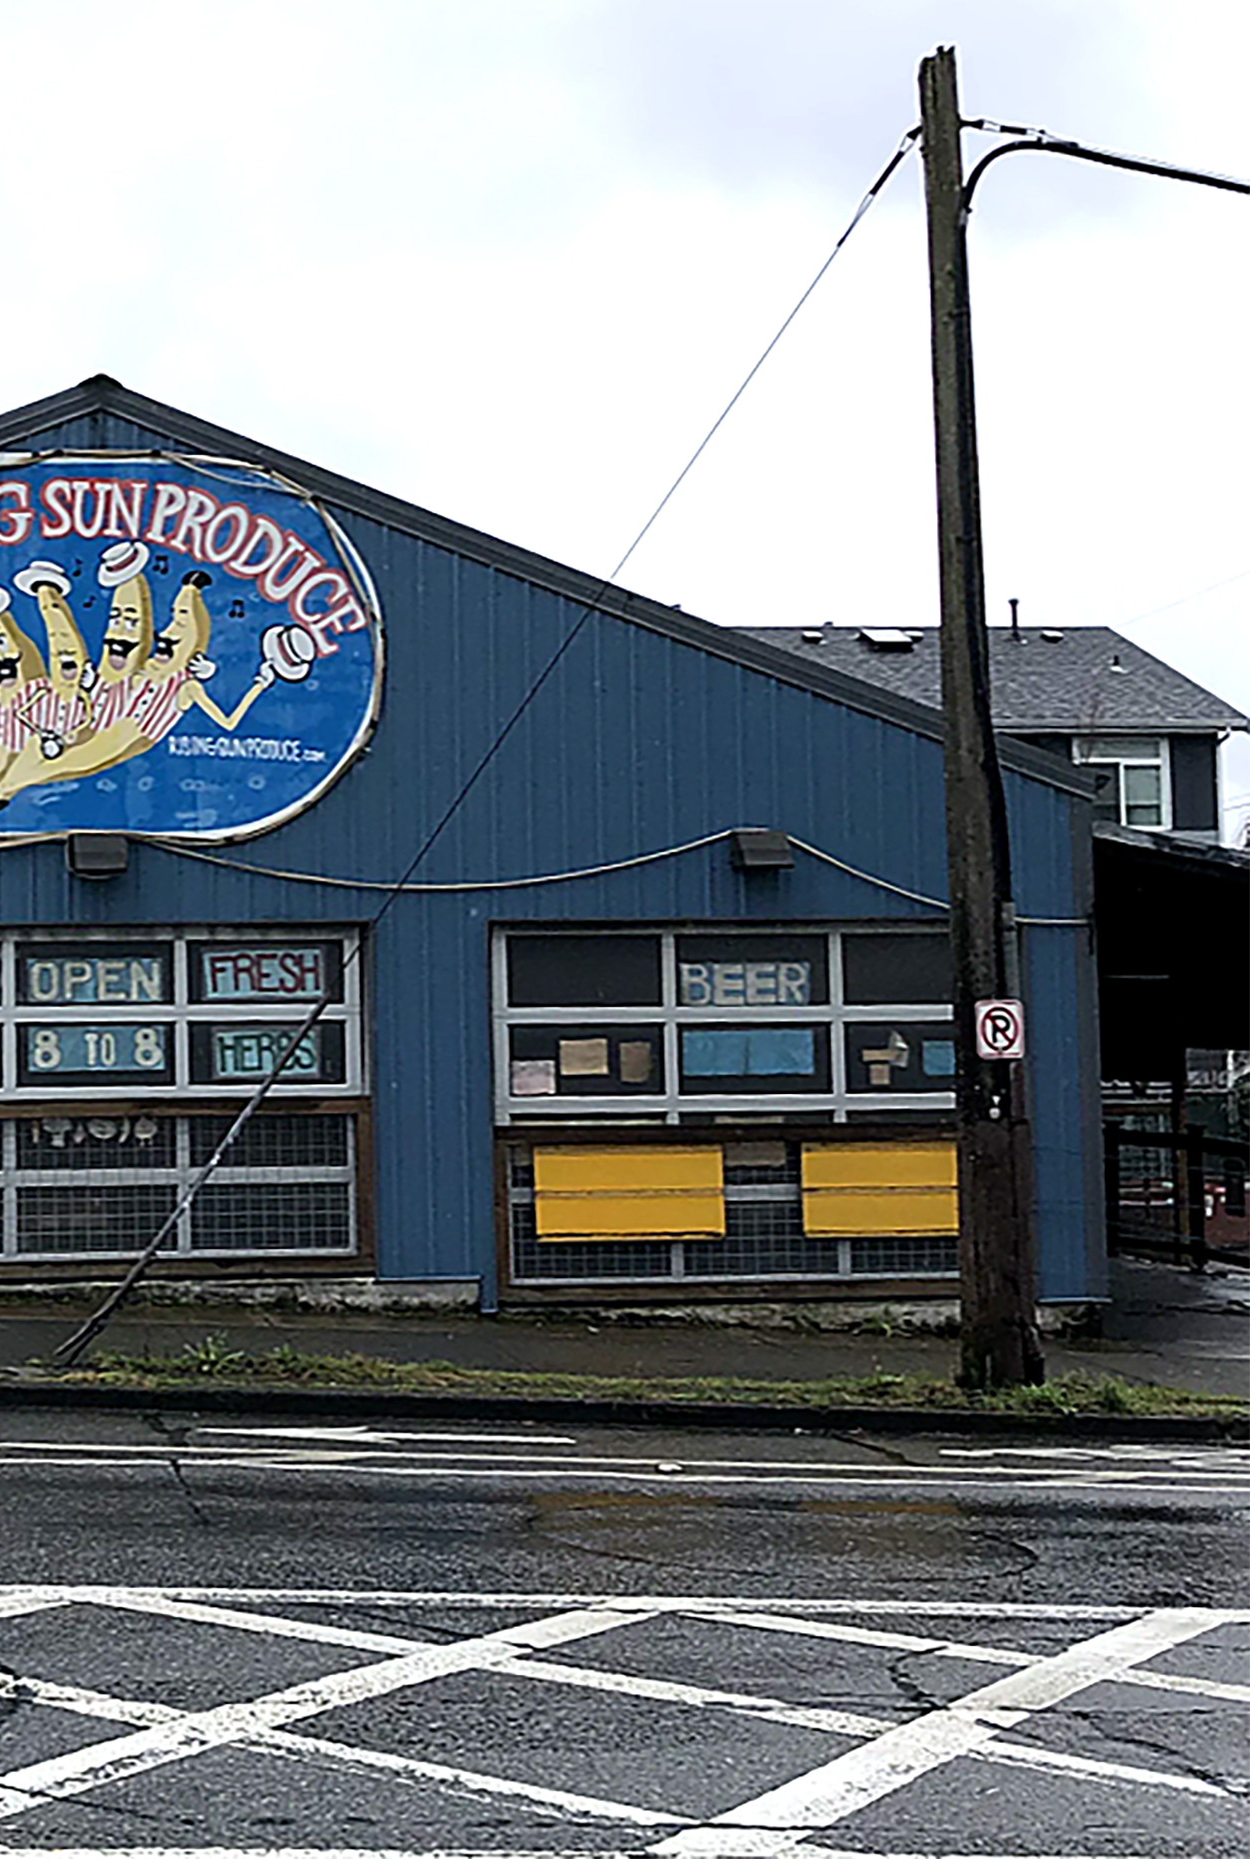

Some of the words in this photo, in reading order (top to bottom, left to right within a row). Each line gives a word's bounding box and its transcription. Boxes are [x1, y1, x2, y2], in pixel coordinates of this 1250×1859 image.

[40, 477, 148, 539] SUN
[144, 480, 367, 658] PRODUCE
[30, 961, 162, 1001] OPEN
[209, 952, 320, 993] FRESH
[679, 962, 809, 1004] BEER
[33, 1029, 62, 1069] 8
[84, 1032, 116, 1067] TO
[134, 1027, 164, 1067] 8
